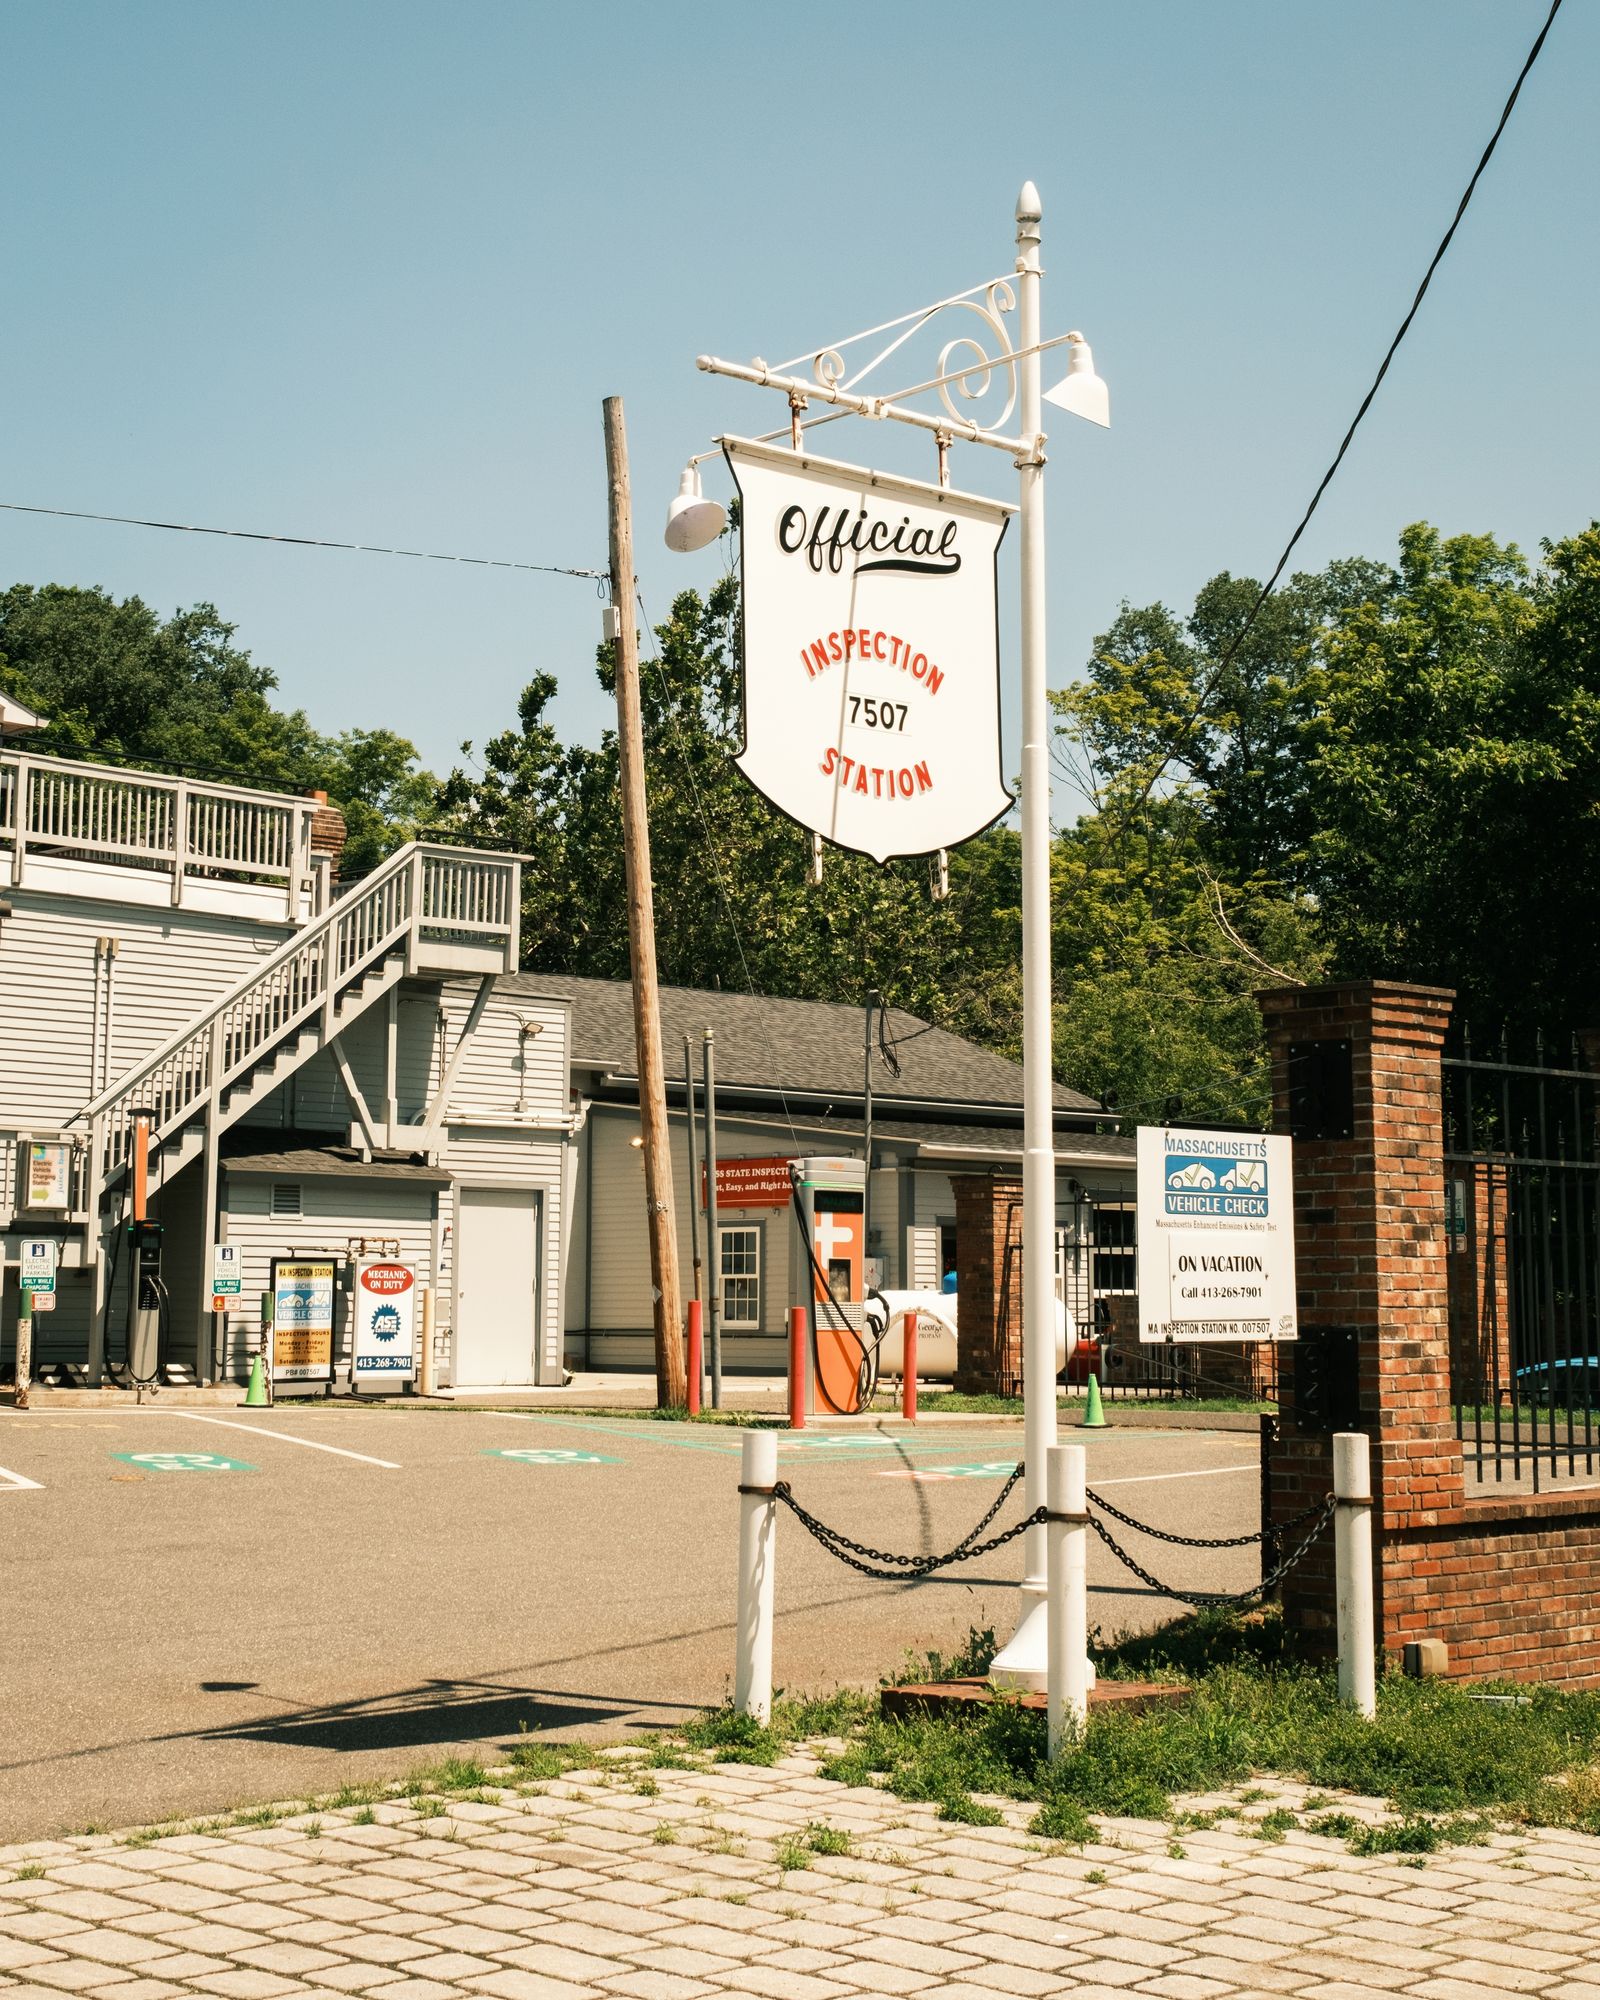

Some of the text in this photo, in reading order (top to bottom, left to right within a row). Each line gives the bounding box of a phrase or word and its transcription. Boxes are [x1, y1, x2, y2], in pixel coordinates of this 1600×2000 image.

[778, 504, 961, 575] Official
[800, 628, 945, 696] INSPECTION
[848, 696, 908, 732] 7507
[820, 747, 933, 799] STATION
[1165, 1138, 1267, 1157] MASSACHUSETTS
[726, 1169, 750, 1178] STATE
[752, 1167, 790, 1176] INSPECTI
[726, 1183, 744, 1192] Easy,
[745, 1182, 759, 1190] and
[760, 1182, 781, 1191] Right
[1168, 1196, 1265, 1215] VEHICLE CHECK
[1155, 1219, 1192, 1228] Massachusetts
[1193, 1221, 1218, 1230] Enhanced
[1219, 1221, 1243, 1230] Emissions
[1250, 1223, 1265, 1232] Safety
[1267, 1223, 1277, 1231] Test
[1178, 1255, 1262, 1272] ON VACATION
[288, 1268, 313, 1276] INSPECTION
[315, 1267, 332, 1276] STATION
[368, 1270, 407, 1279] MECHANIC
[370, 1280, 404, 1289] ON DUTY
[1181, 1286, 1262, 1298] Call 413-268-7901
[278, 1310, 330, 1319] VEHICLE CHECK
[374, 1315, 397, 1329] ASE
[1148, 1323, 1158, 1334] MA
[1161, 1323, 1199, 1334] INSPECTION
[1200, 1323, 1227, 1334] STATION
[1229, 1323, 1240, 1334] NO.
[1242, 1323, 1270, 1333] 007507
[358, 1357, 411, 1368] 413-268-7901
